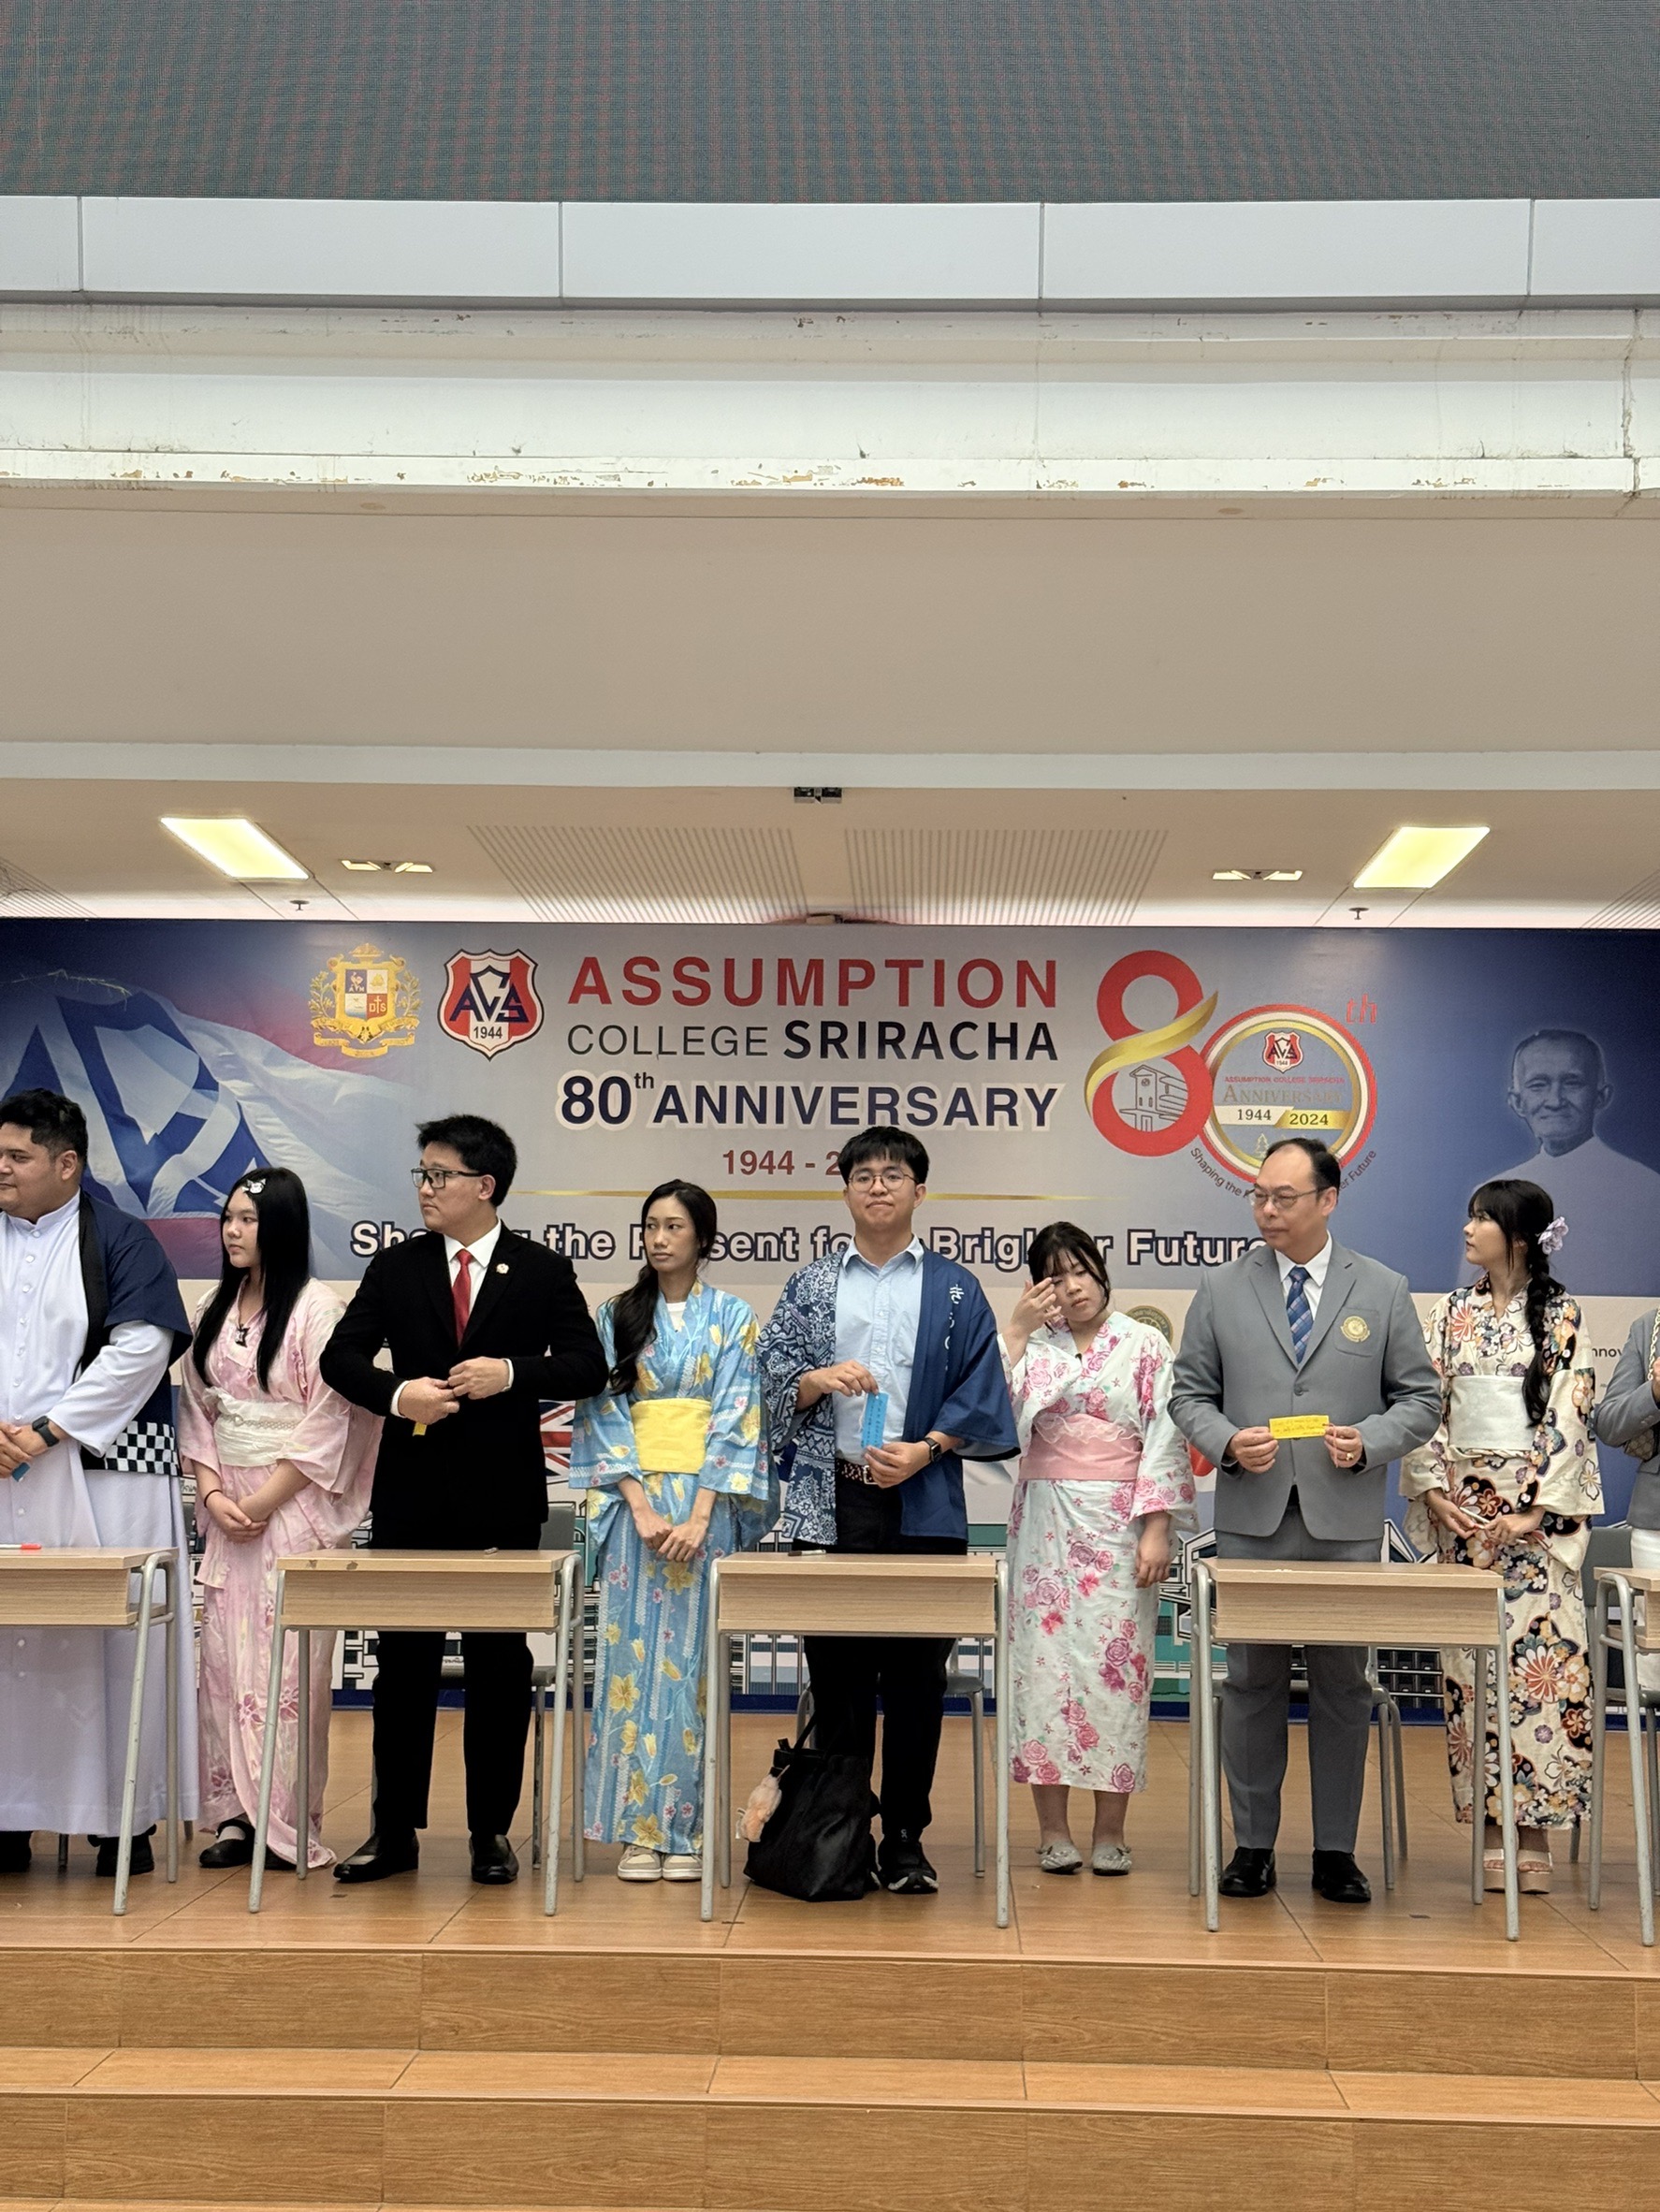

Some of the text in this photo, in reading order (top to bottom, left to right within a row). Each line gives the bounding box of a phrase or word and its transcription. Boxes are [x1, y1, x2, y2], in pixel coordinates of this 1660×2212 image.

[567, 955, 1057, 1010] ASSUMPTION
[473, 1026, 503, 1040] 1944
[567, 1019, 1059, 1061] COLLEGE SRIRACHA
[652, 1084, 1059, 1128] ANNIVERSARY
[1236, 1108, 1273, 1122] 1944
[1289, 1113, 1330, 1127] 2024
[721, 1149, 795, 1176] 1944
[1190, 1147, 1377, 1197] Shaping the Future
[544, 1223, 617, 1260] the
[929, 1227, 1114, 1273] Brigr
